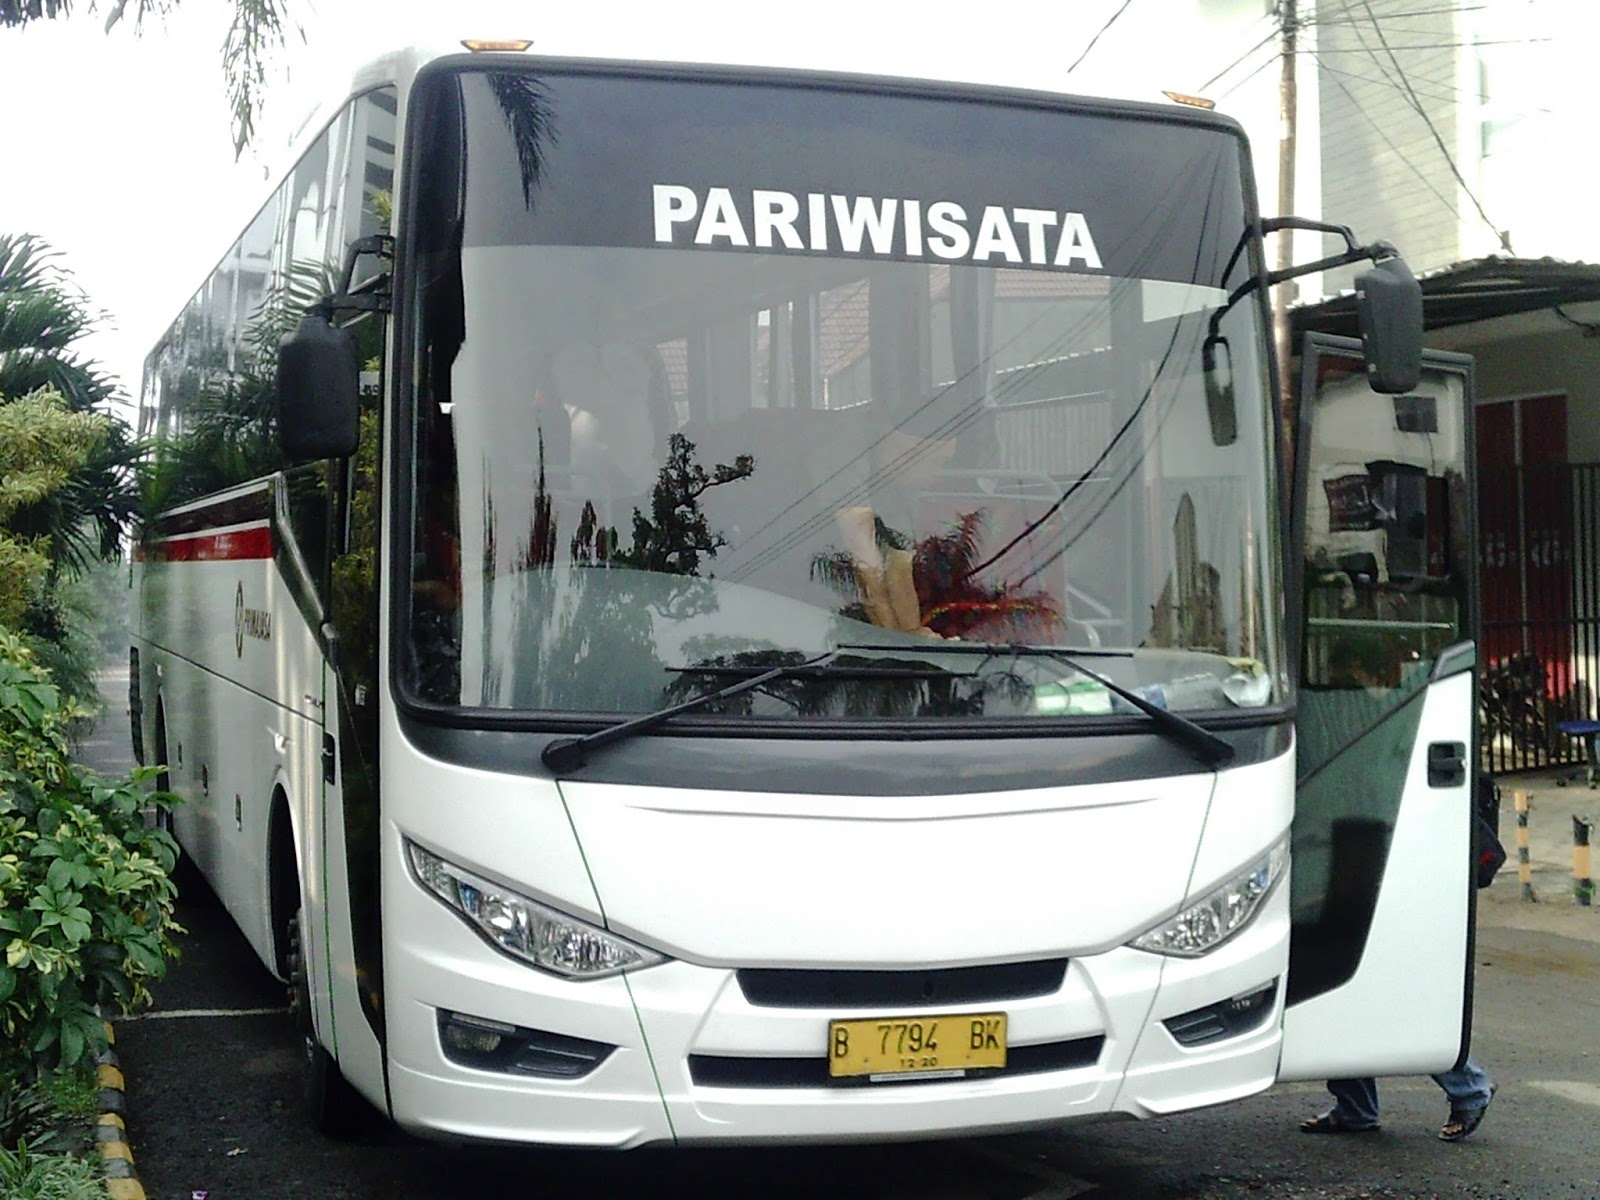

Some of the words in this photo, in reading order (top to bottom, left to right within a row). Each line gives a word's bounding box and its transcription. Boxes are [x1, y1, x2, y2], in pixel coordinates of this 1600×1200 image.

[652, 184, 1103, 269] PARIWISATA
[834, 1027, 849, 1058] B
[877, 1022, 938, 1055] 7794
[970, 1020, 1001, 1050] BK
